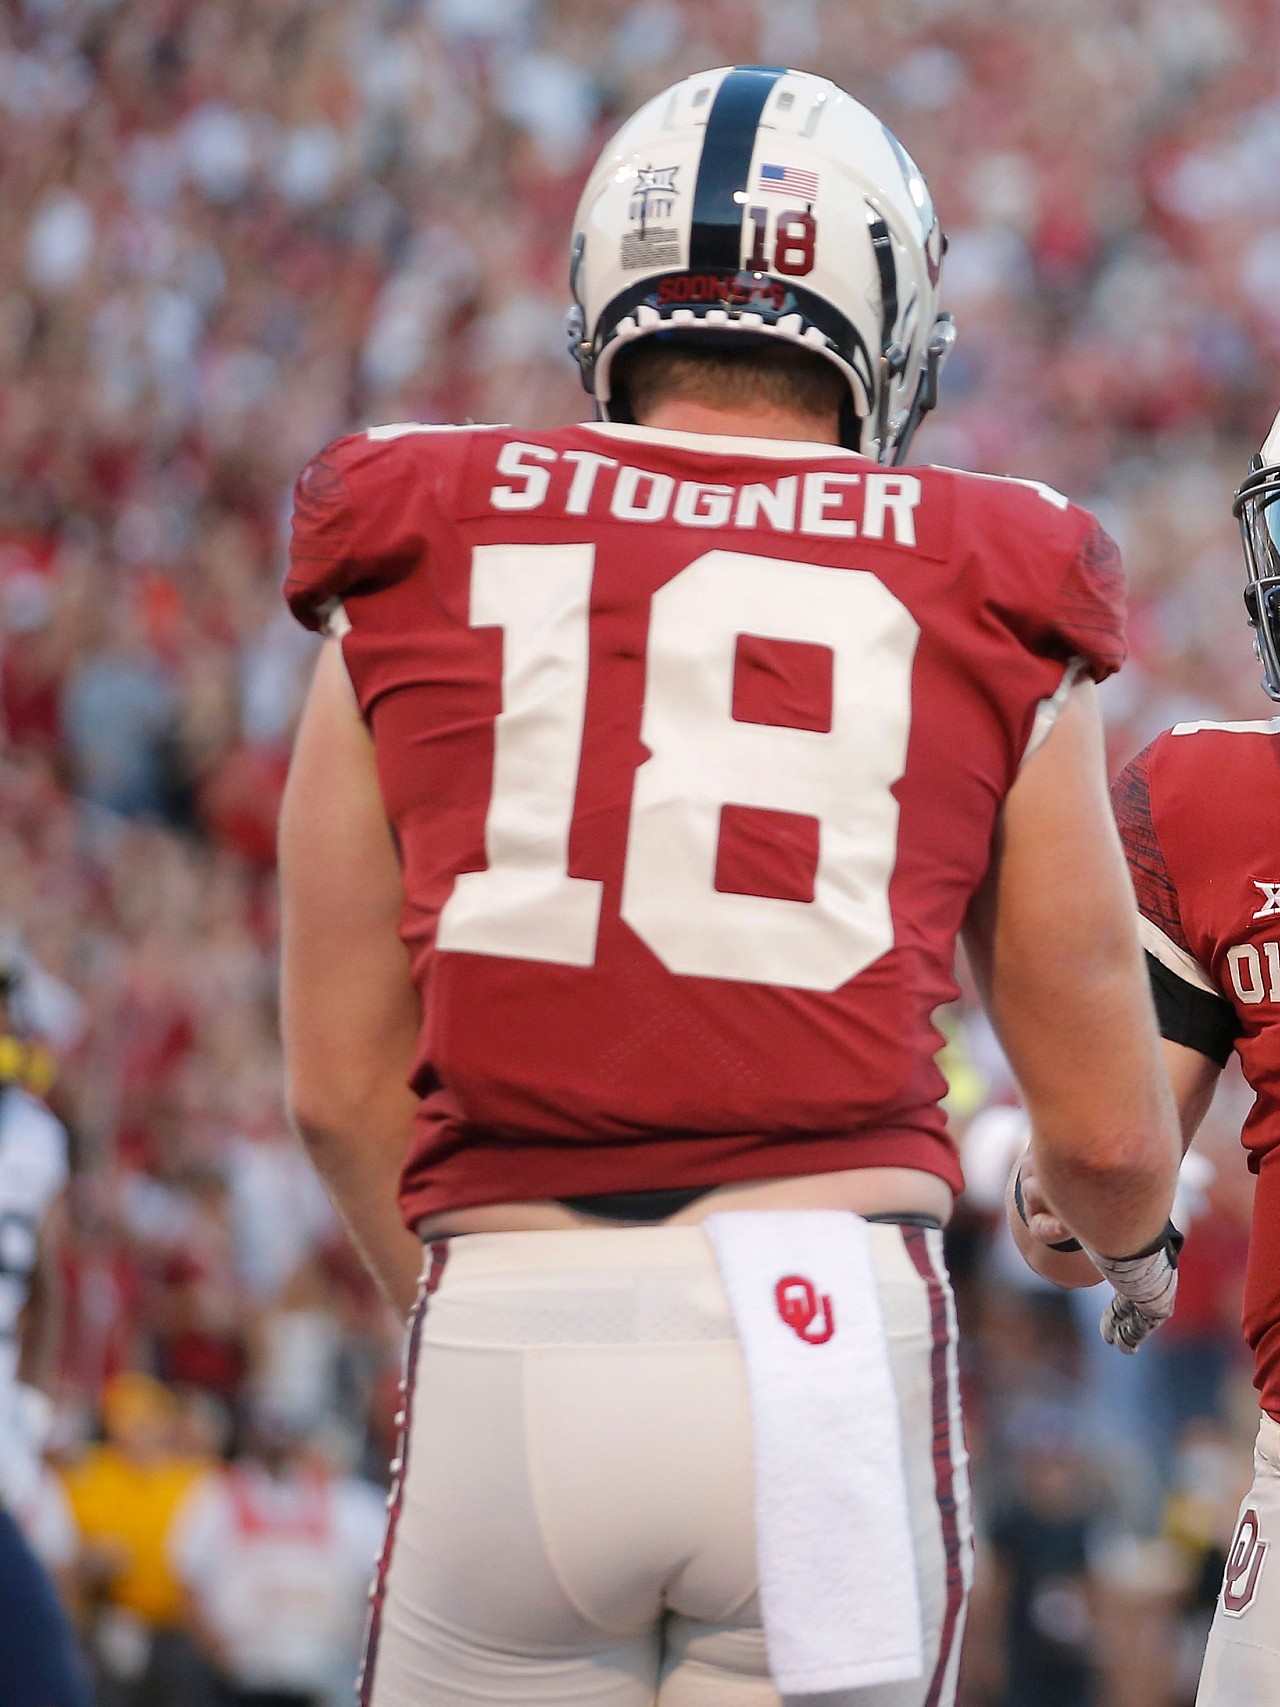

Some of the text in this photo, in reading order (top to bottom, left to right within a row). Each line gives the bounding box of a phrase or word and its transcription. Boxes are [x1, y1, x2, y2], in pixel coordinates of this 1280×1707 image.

[746, 205, 817, 276] 18
[490, 440, 922, 546] STOGNER
[436, 543, 921, 992] 18
[775, 1275, 835, 1345] OU
[1223, 1507, 1267, 1613] OU
